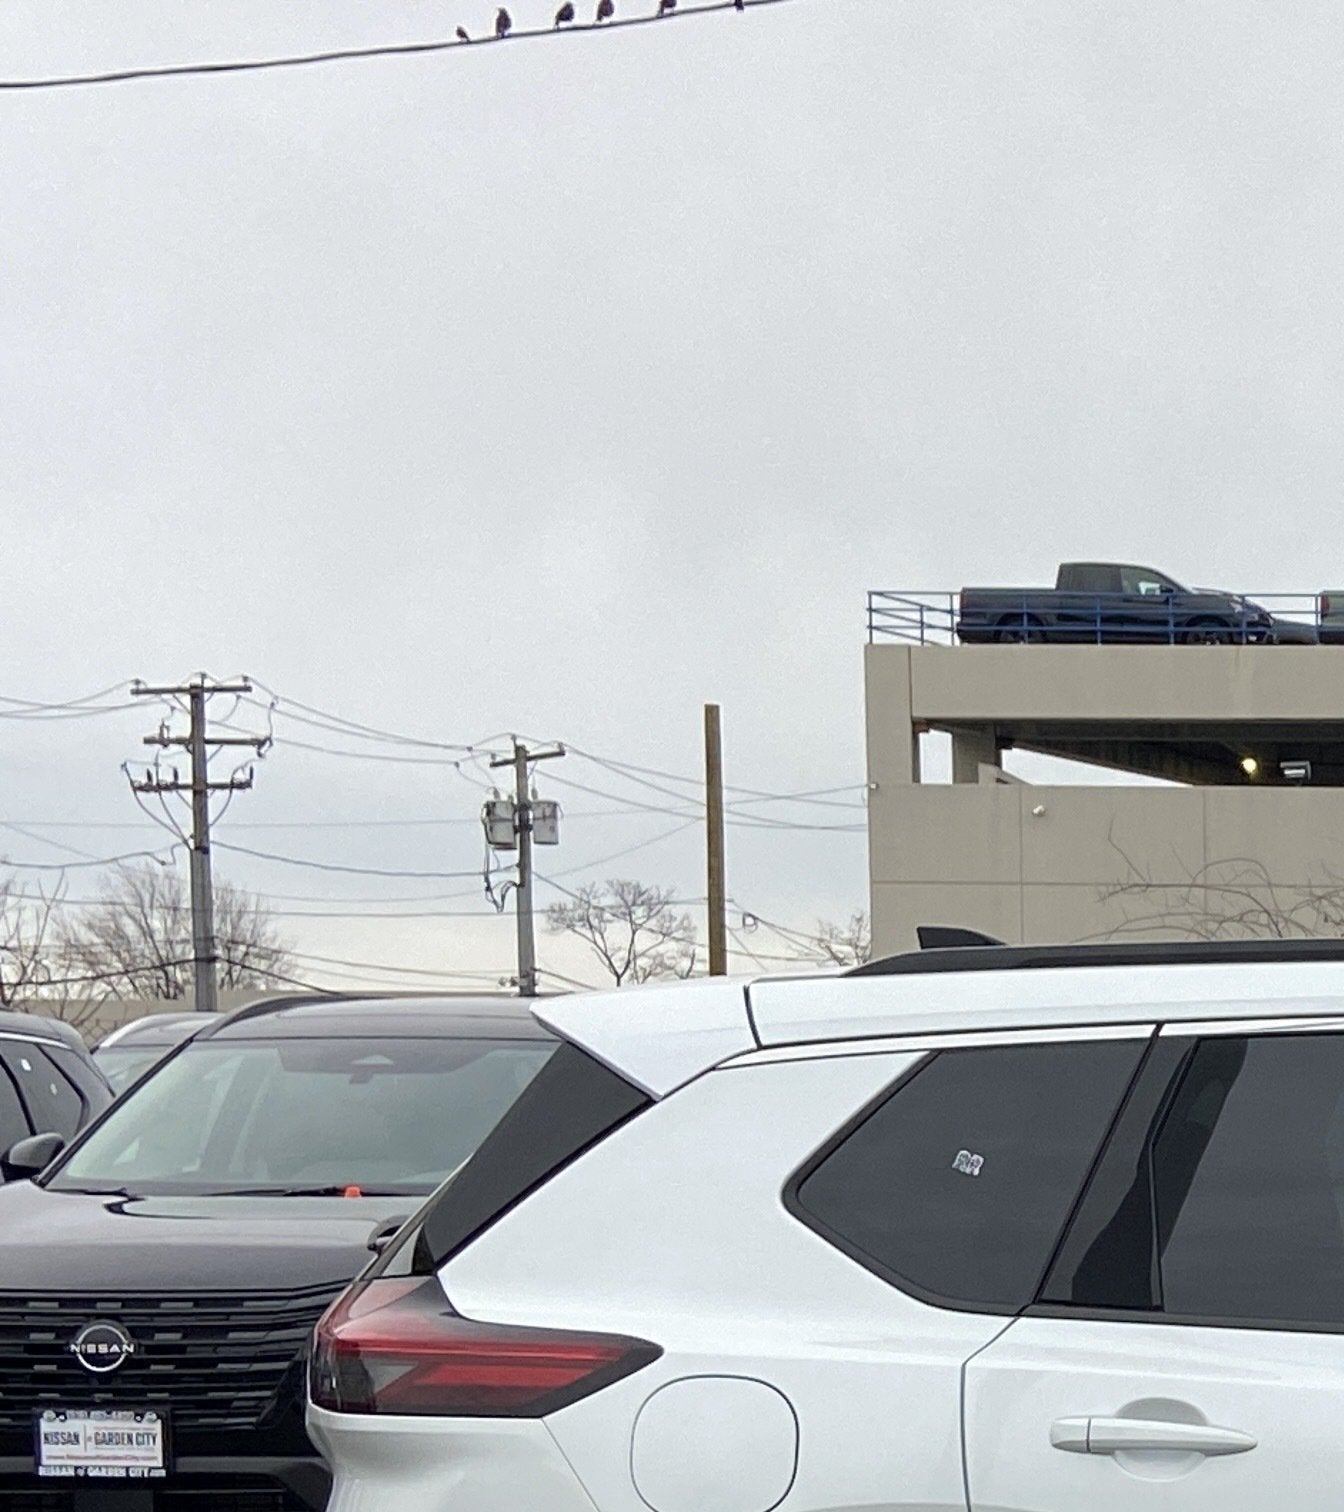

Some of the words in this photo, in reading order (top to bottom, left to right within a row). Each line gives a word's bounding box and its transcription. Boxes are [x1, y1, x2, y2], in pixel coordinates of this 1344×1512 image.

[70, 1343, 135, 1354] NISSAN
[43, 1431, 81, 1446] NISSAN
[93, 1431, 134, 1446] GARDEN
[135, 1431, 158, 1446] CITY
